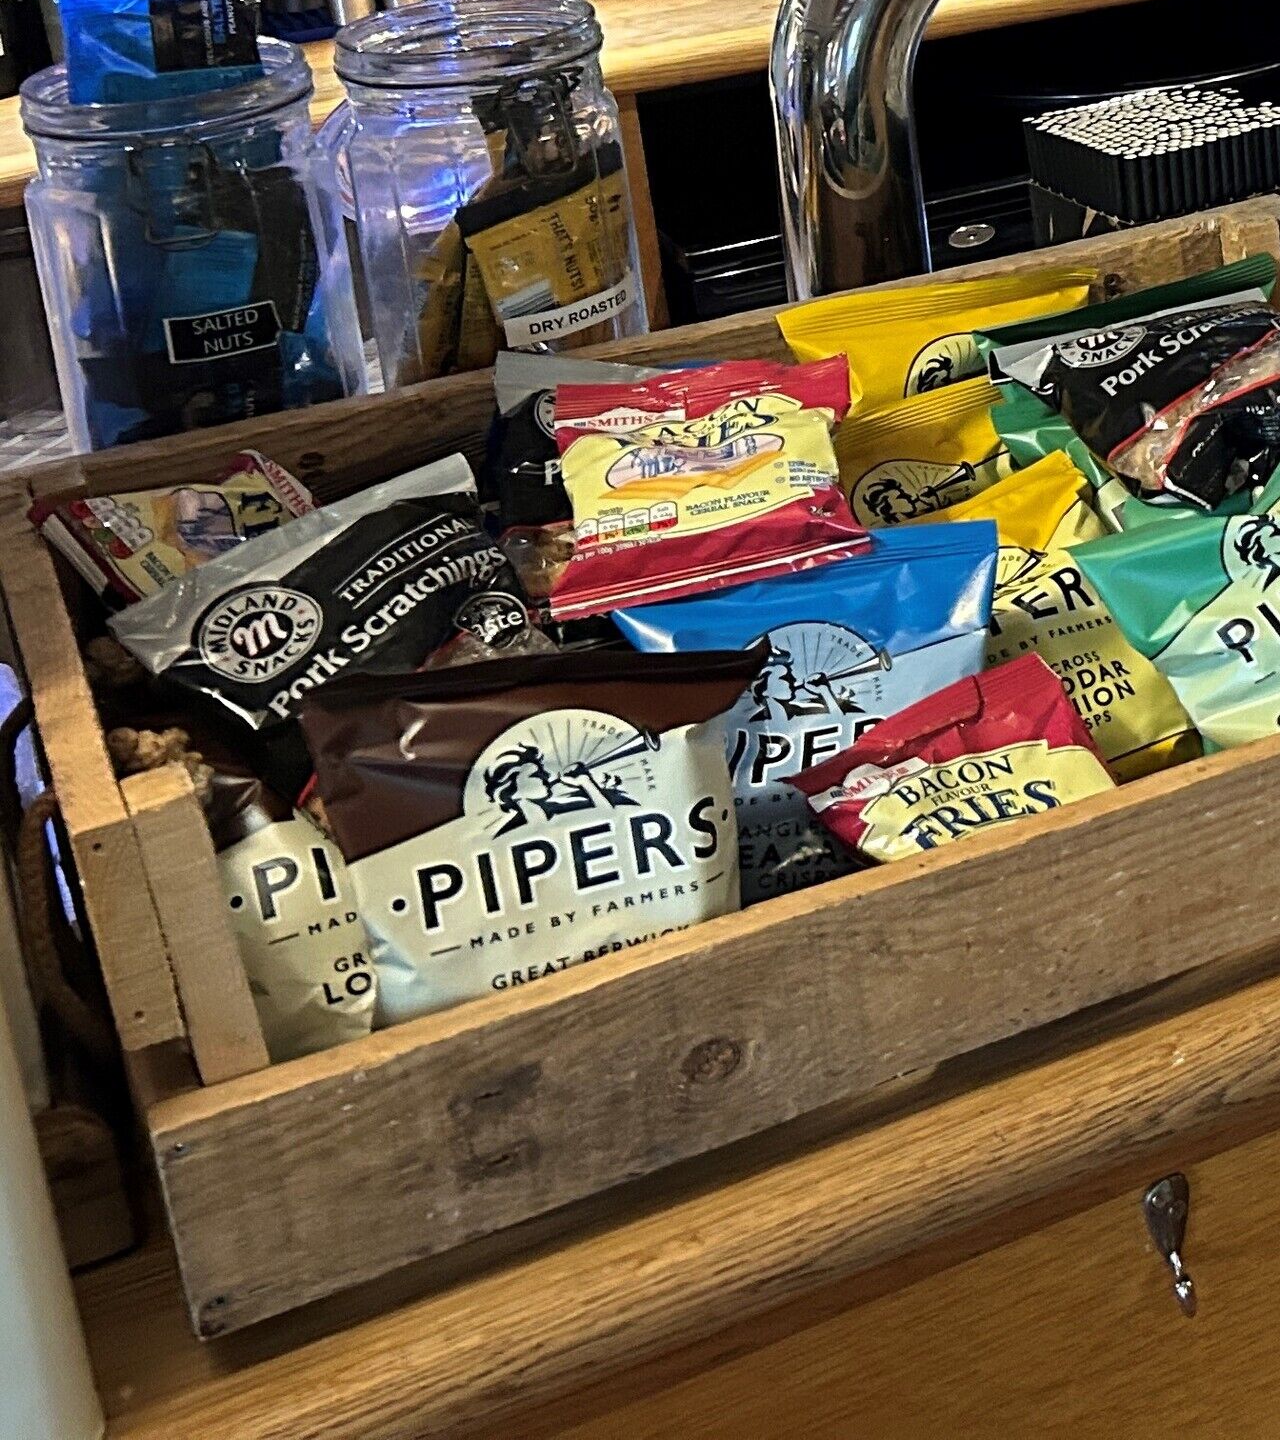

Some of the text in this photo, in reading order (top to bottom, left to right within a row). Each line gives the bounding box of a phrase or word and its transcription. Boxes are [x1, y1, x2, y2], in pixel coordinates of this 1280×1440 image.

[192, 309, 258, 335] SALTED
[529, 289, 627, 335] DRY ROASTED
[203, 330, 254, 354] NUTS
[1099, 350, 1165, 397] Pork
[585, 415, 655, 428] SMITHS
[339, 517, 476, 603] TRADITIONAL
[207, 593, 299, 654] MIDLAND
[234, 618, 315, 676] SNACKS
[269, 546, 508, 719] Pork Scratchings
[1018, 615, 1113, 651] BY FARMERS
[895, 754, 1015, 808] BACON
[931, 782, 993, 807] FLAVOUR
[899, 780, 1061, 850] FRIES
[417, 796, 719, 931] PIPERS
[470, 881, 700, 950] MADE BY FARMERS
[492, 957, 569, 991] GREAT
